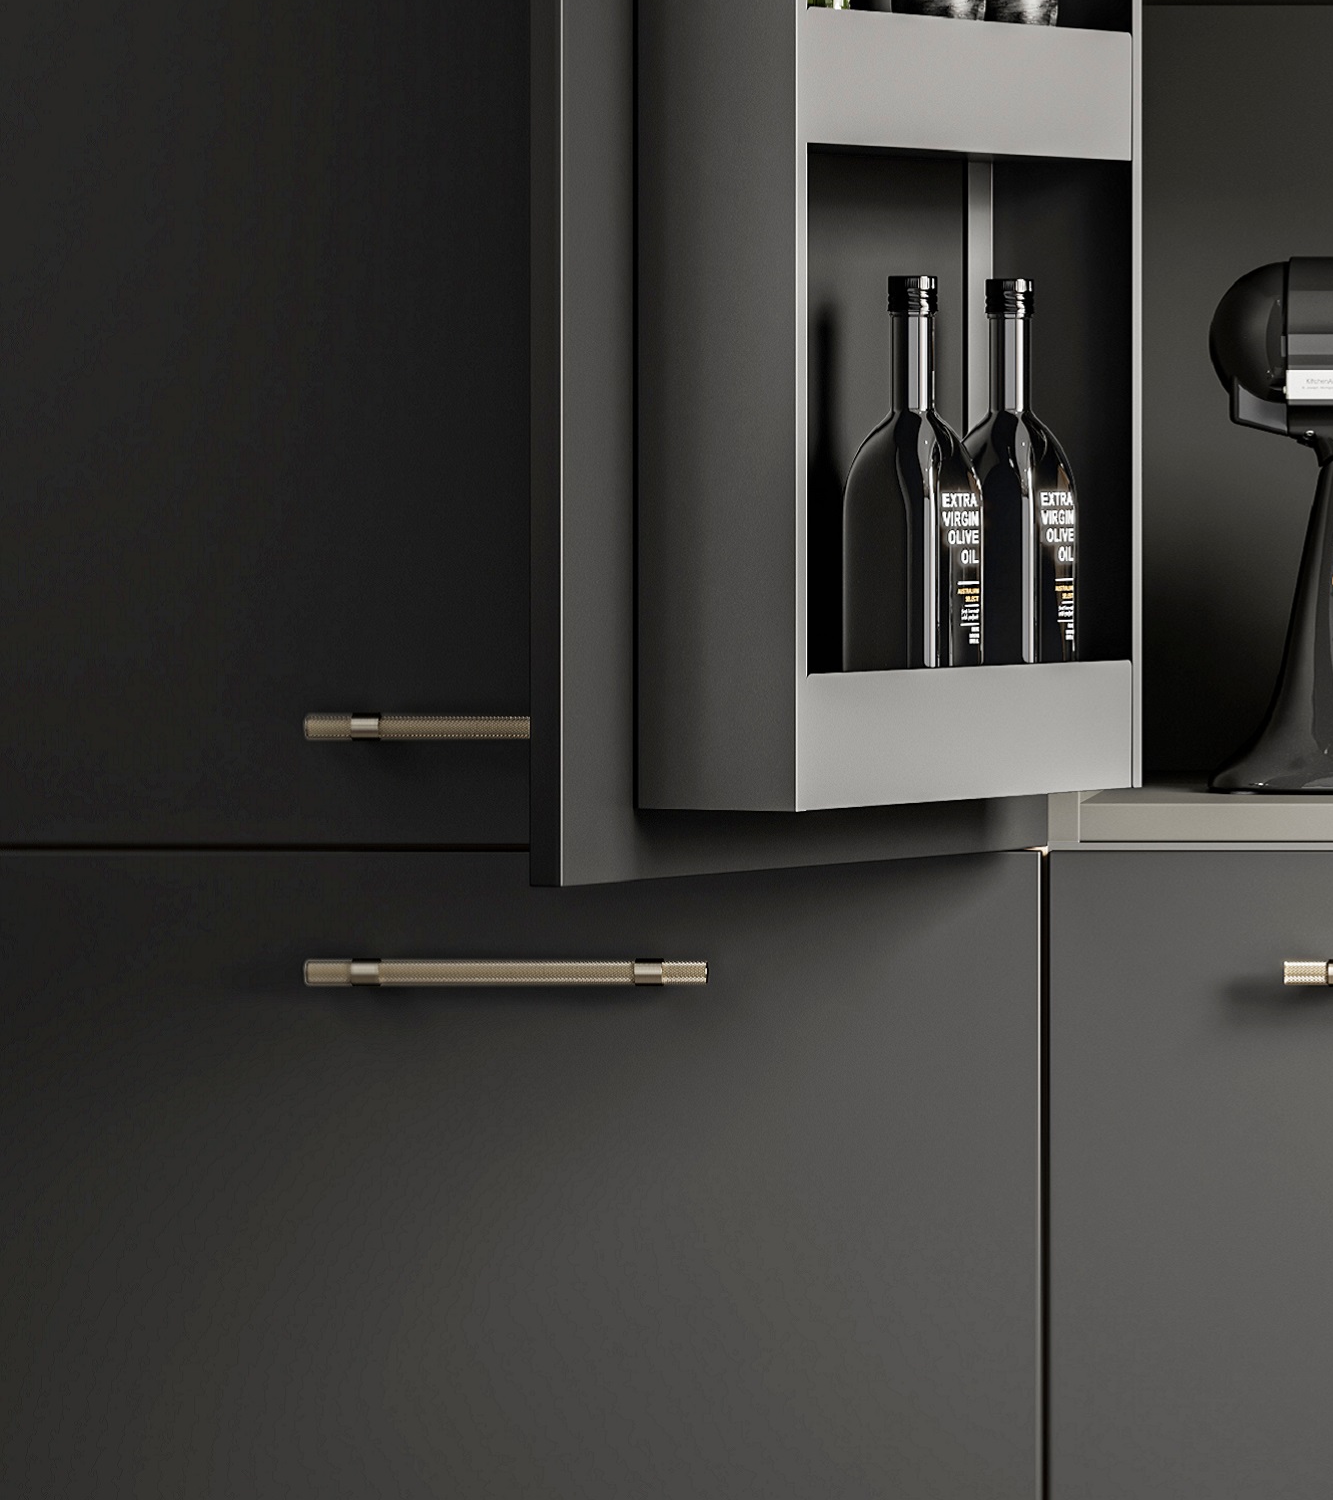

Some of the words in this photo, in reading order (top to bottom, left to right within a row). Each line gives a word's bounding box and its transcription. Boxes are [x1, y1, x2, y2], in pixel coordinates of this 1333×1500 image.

[941, 492, 978, 507] EXTRA
[1040, 491, 1074, 506] EXTRA
[942, 511, 979, 527] VIRGIN
[1041, 509, 1075, 525] VIRGIN
[948, 529, 979, 544] OLIVE
[1046, 527, 1075, 542] OLIVE
[961, 549, 979, 564] OIL
[1058, 546, 1075, 561] OIL
